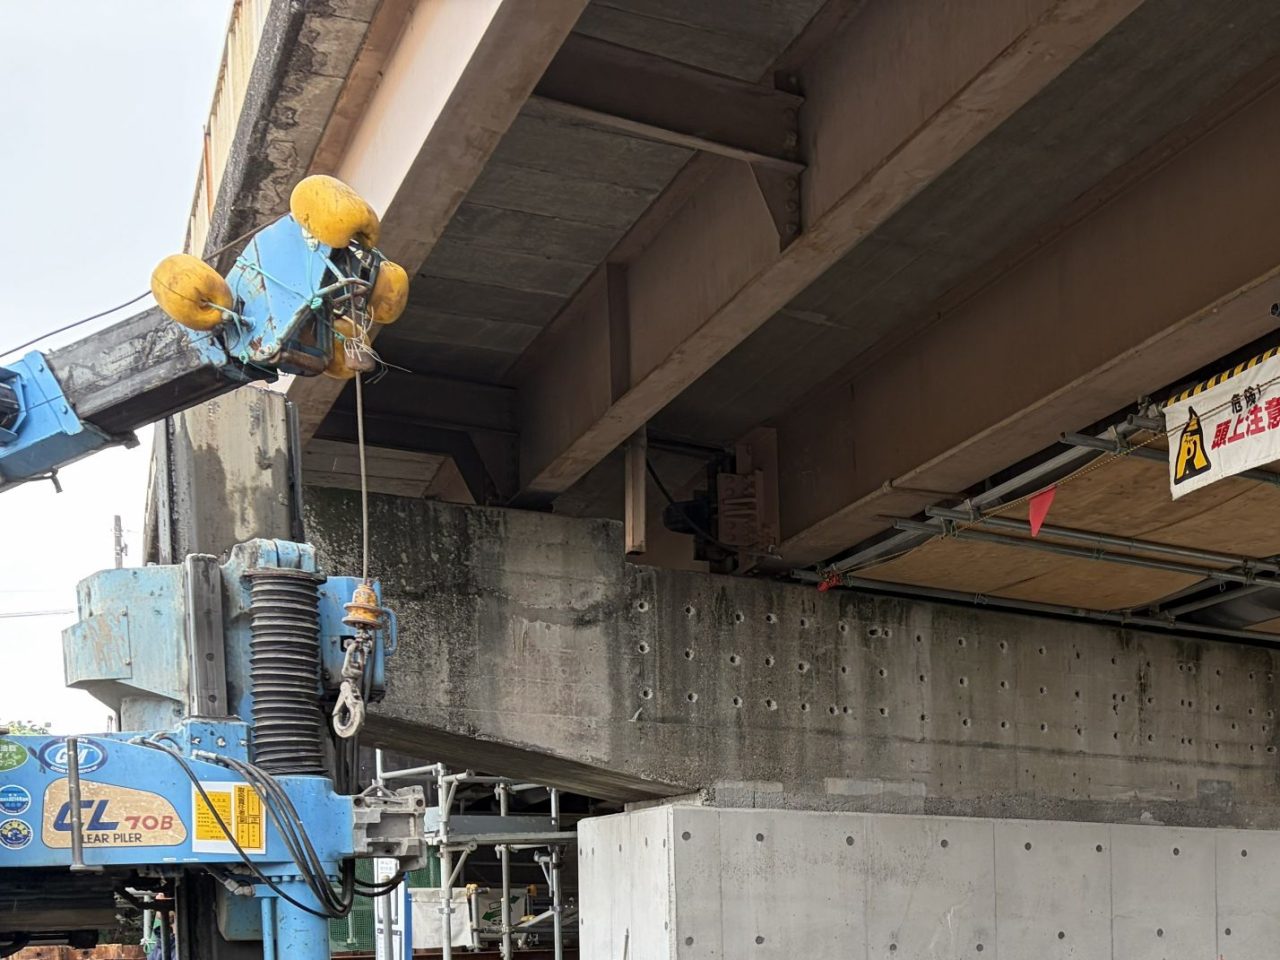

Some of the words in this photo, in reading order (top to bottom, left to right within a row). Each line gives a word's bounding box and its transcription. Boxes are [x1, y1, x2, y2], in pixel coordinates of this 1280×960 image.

[53, 799, 119, 831] CL
[125, 815, 174, 830] 70B
[81, 833, 109, 844] LEAR
[113, 833, 142, 843] PILER
